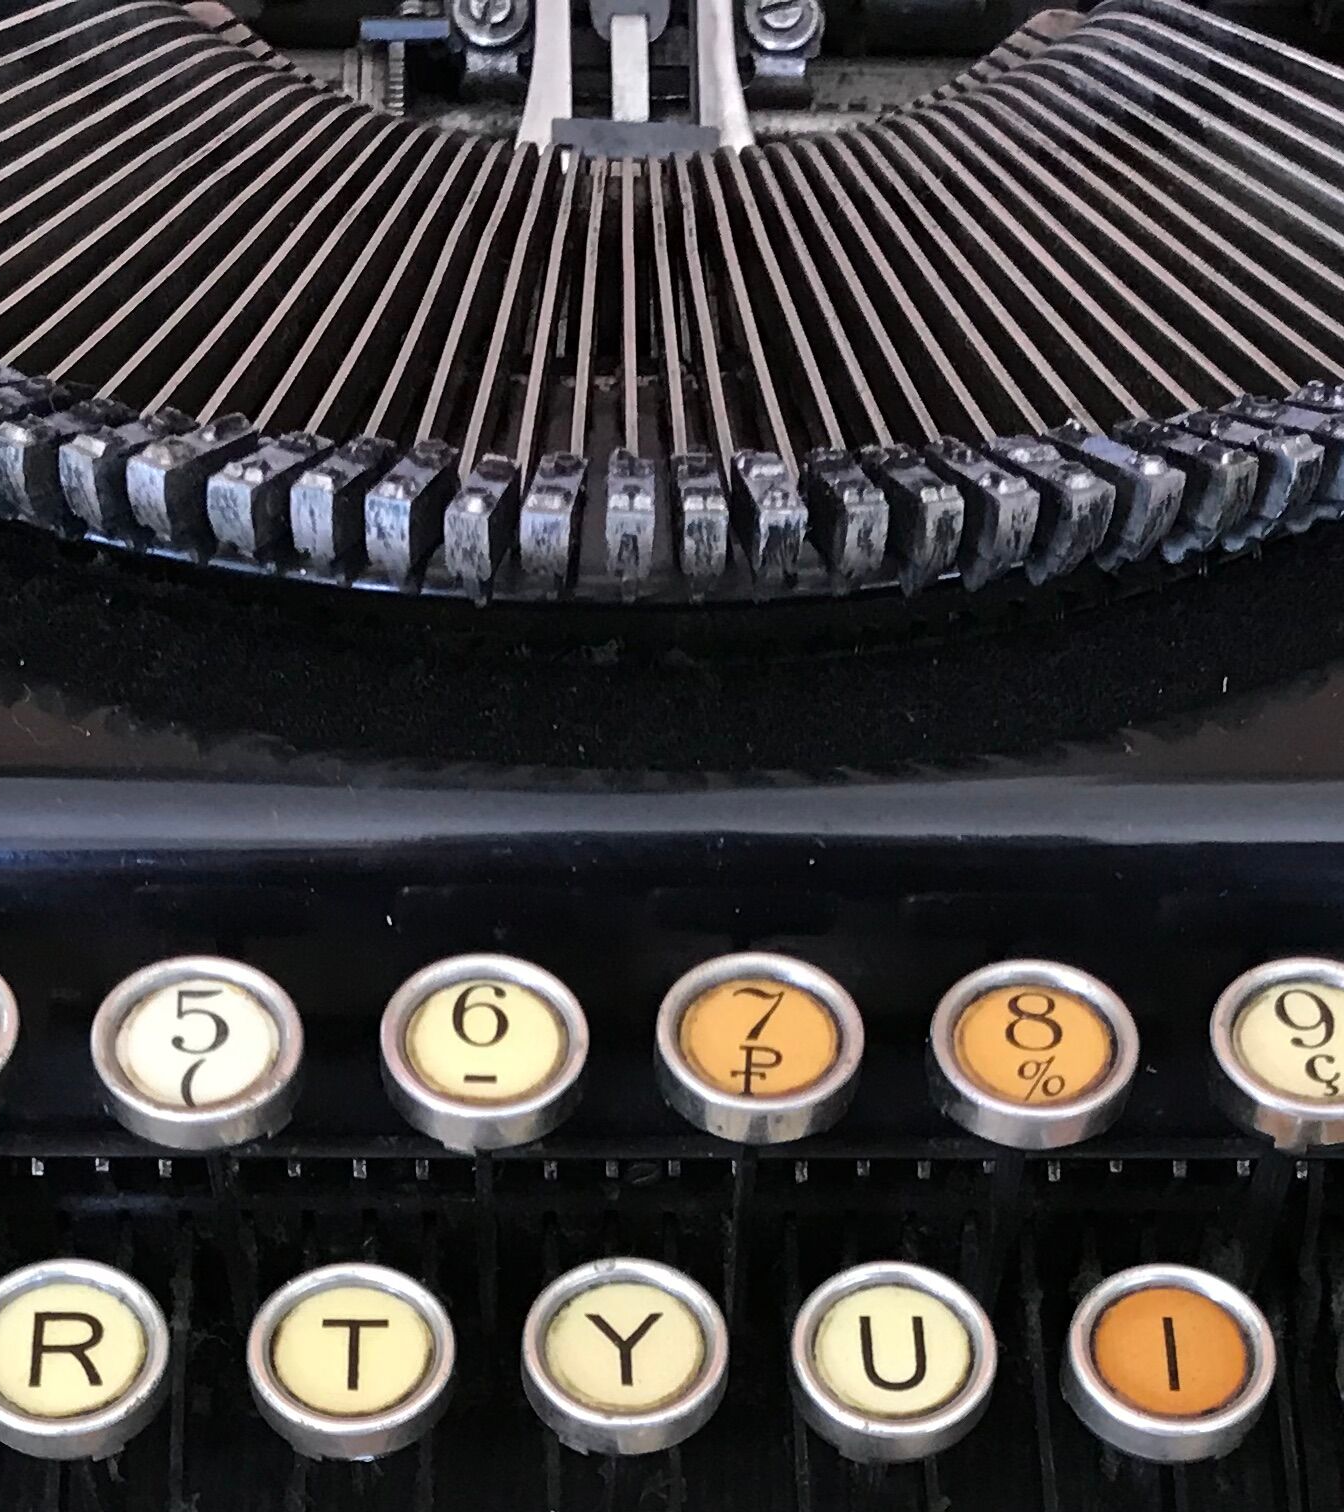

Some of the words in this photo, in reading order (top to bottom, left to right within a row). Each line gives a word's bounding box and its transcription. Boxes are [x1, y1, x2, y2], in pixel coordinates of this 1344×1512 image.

[171, 989, 230, 1053] 5
[452, 983, 509, 1045] 6
[734, 987, 785, 1040] 7
[1006, 993, 1063, 1049] 8
[1275, 990, 1337, 1048] 9
[1018, 1057, 1066, 1101] %
[1303, 1055, 1341, 1097] ç
[29, 1312, 103, 1387] R
[323, 1319, 388, 1390] T
[586, 1313, 662, 1386] Y
[860, 1316, 926, 1391] U
[1163, 1317, 1180, 1391] I
